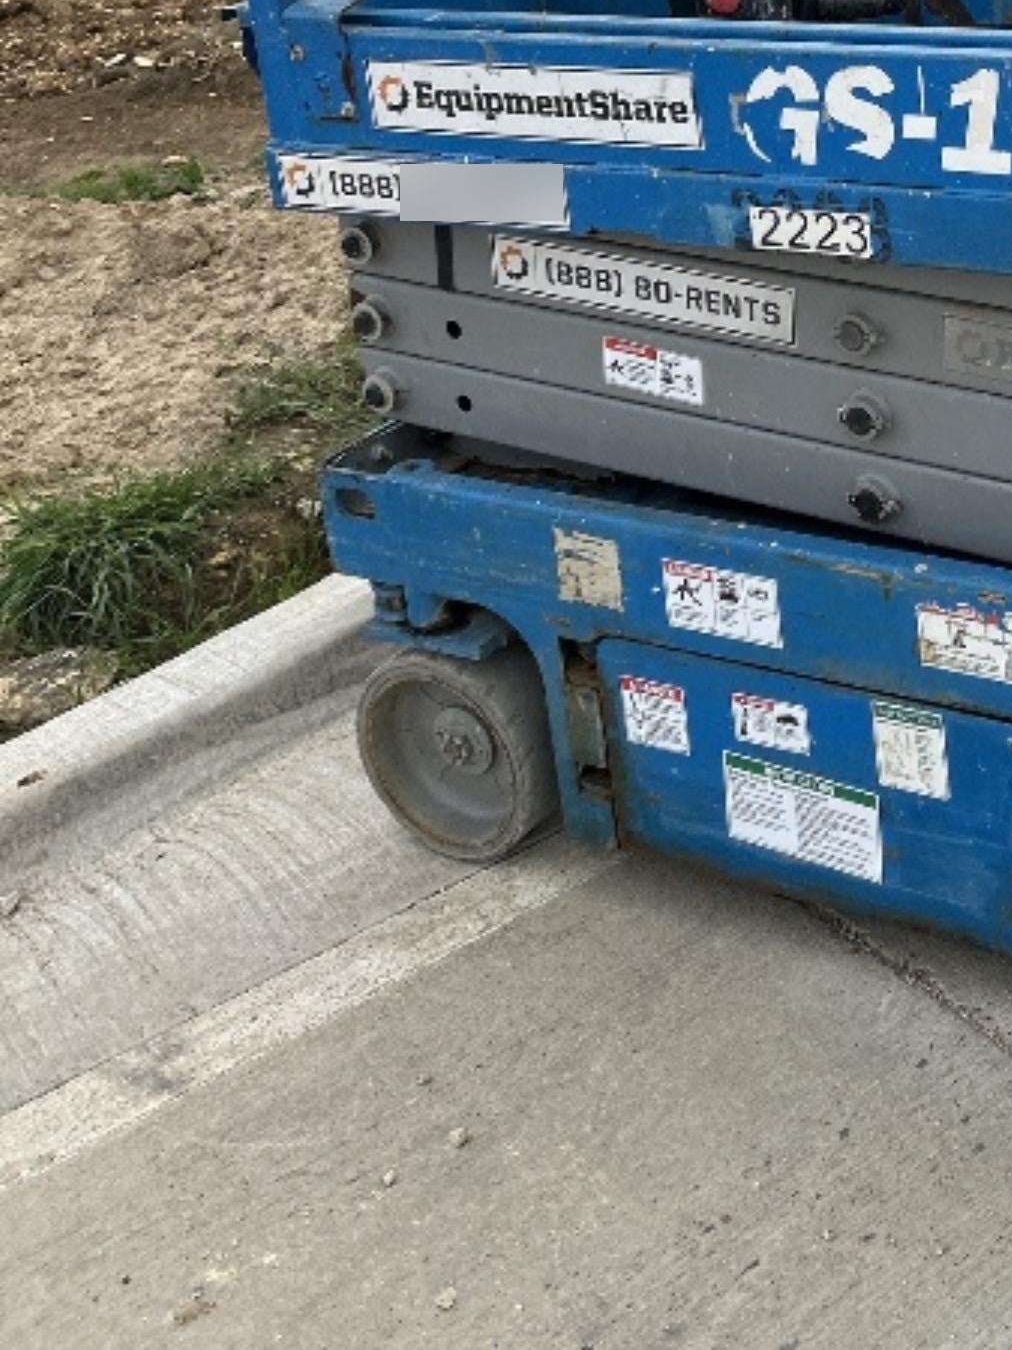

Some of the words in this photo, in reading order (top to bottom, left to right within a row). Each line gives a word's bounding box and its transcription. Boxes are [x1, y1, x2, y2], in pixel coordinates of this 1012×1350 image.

[413, 81, 690, 124] EquipmentShare
[329, 170, 400, 201] (888)
[758, 208, 868, 254] 2223
[545, 257, 624, 297] (888)
[634, 274, 782, 326] 80-RENTS
